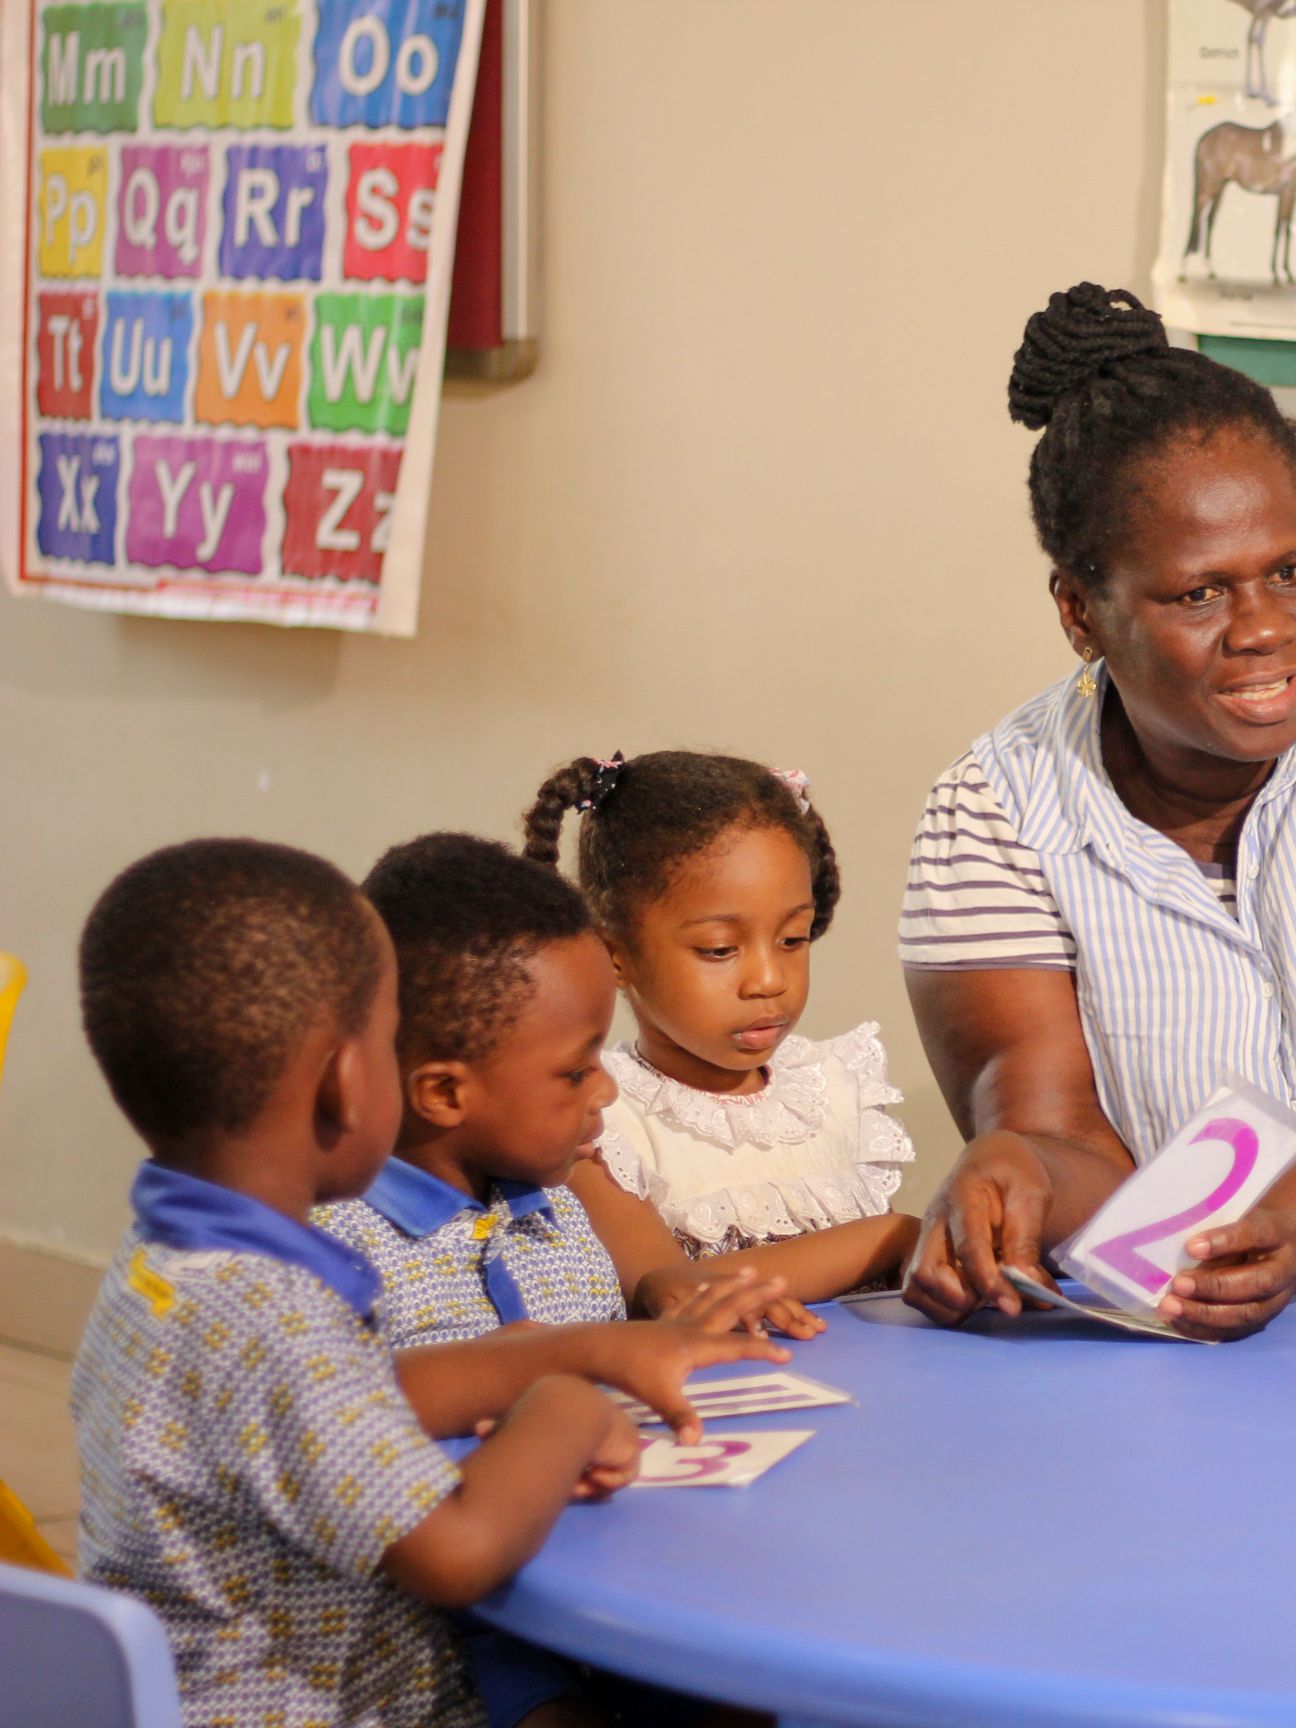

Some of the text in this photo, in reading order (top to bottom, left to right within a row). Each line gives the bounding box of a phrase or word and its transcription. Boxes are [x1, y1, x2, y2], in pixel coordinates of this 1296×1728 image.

[48, 31, 126, 107] Mm
[181, 25, 266, 102] Nn
[340, 15, 440, 97] Oo
[45, 172, 98, 266] Pp
[123, 166, 199, 266] Qq
[233, 167, 315, 249] Rr
[48, 315, 83, 394] Tt
[109, 317, 173, 397] Uu
[213, 321, 292, 402] Vv
[57, 454, 101, 534] Xx
[154, 460, 235, 563] Yy
[1089, 1117, 1259, 1296] 2
